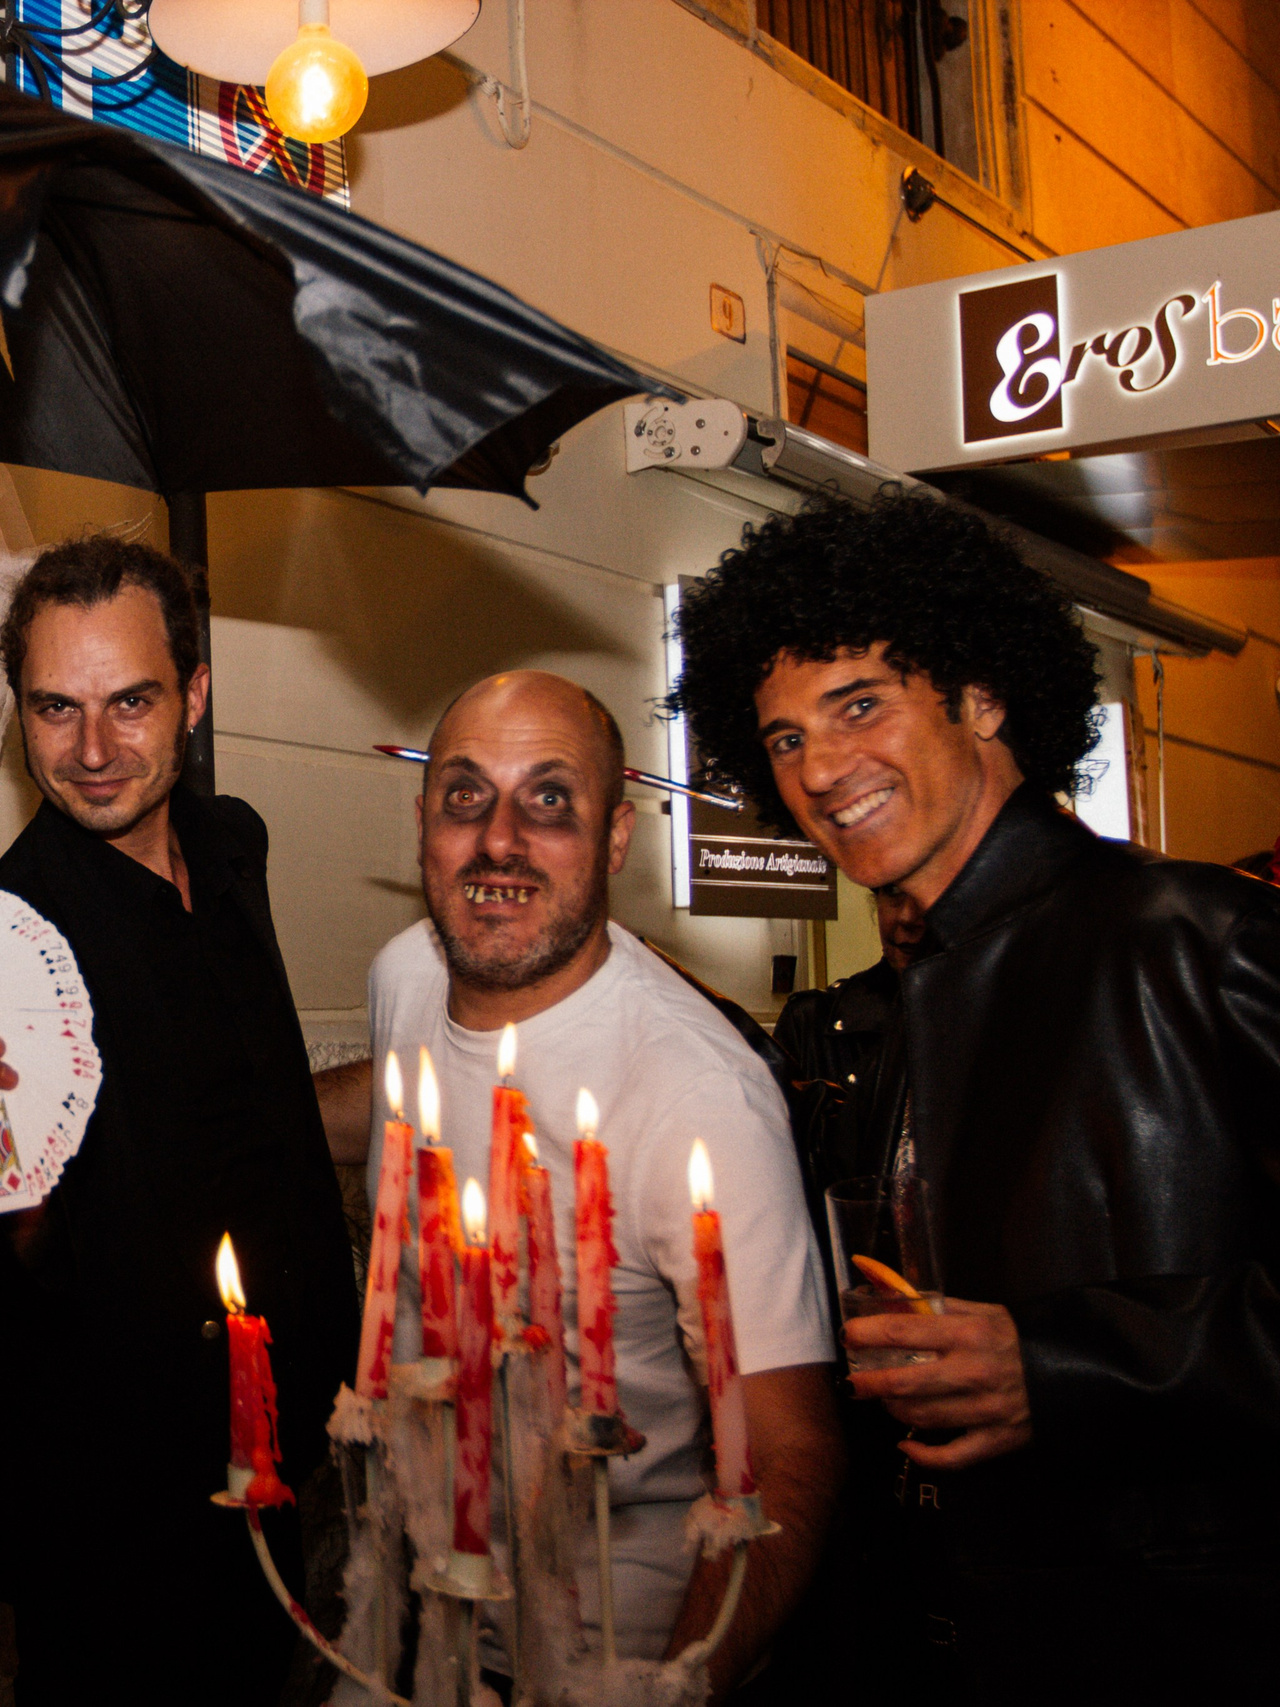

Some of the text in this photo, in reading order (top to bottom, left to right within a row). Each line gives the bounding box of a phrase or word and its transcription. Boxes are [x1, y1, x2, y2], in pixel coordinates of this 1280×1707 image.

[722, 296, 733, 331] 9
[988, 280, 1280, 424] Eros b
[699, 849, 827, 877] Produzione Artigianale
[76, 1098, 89, 1110] 8
